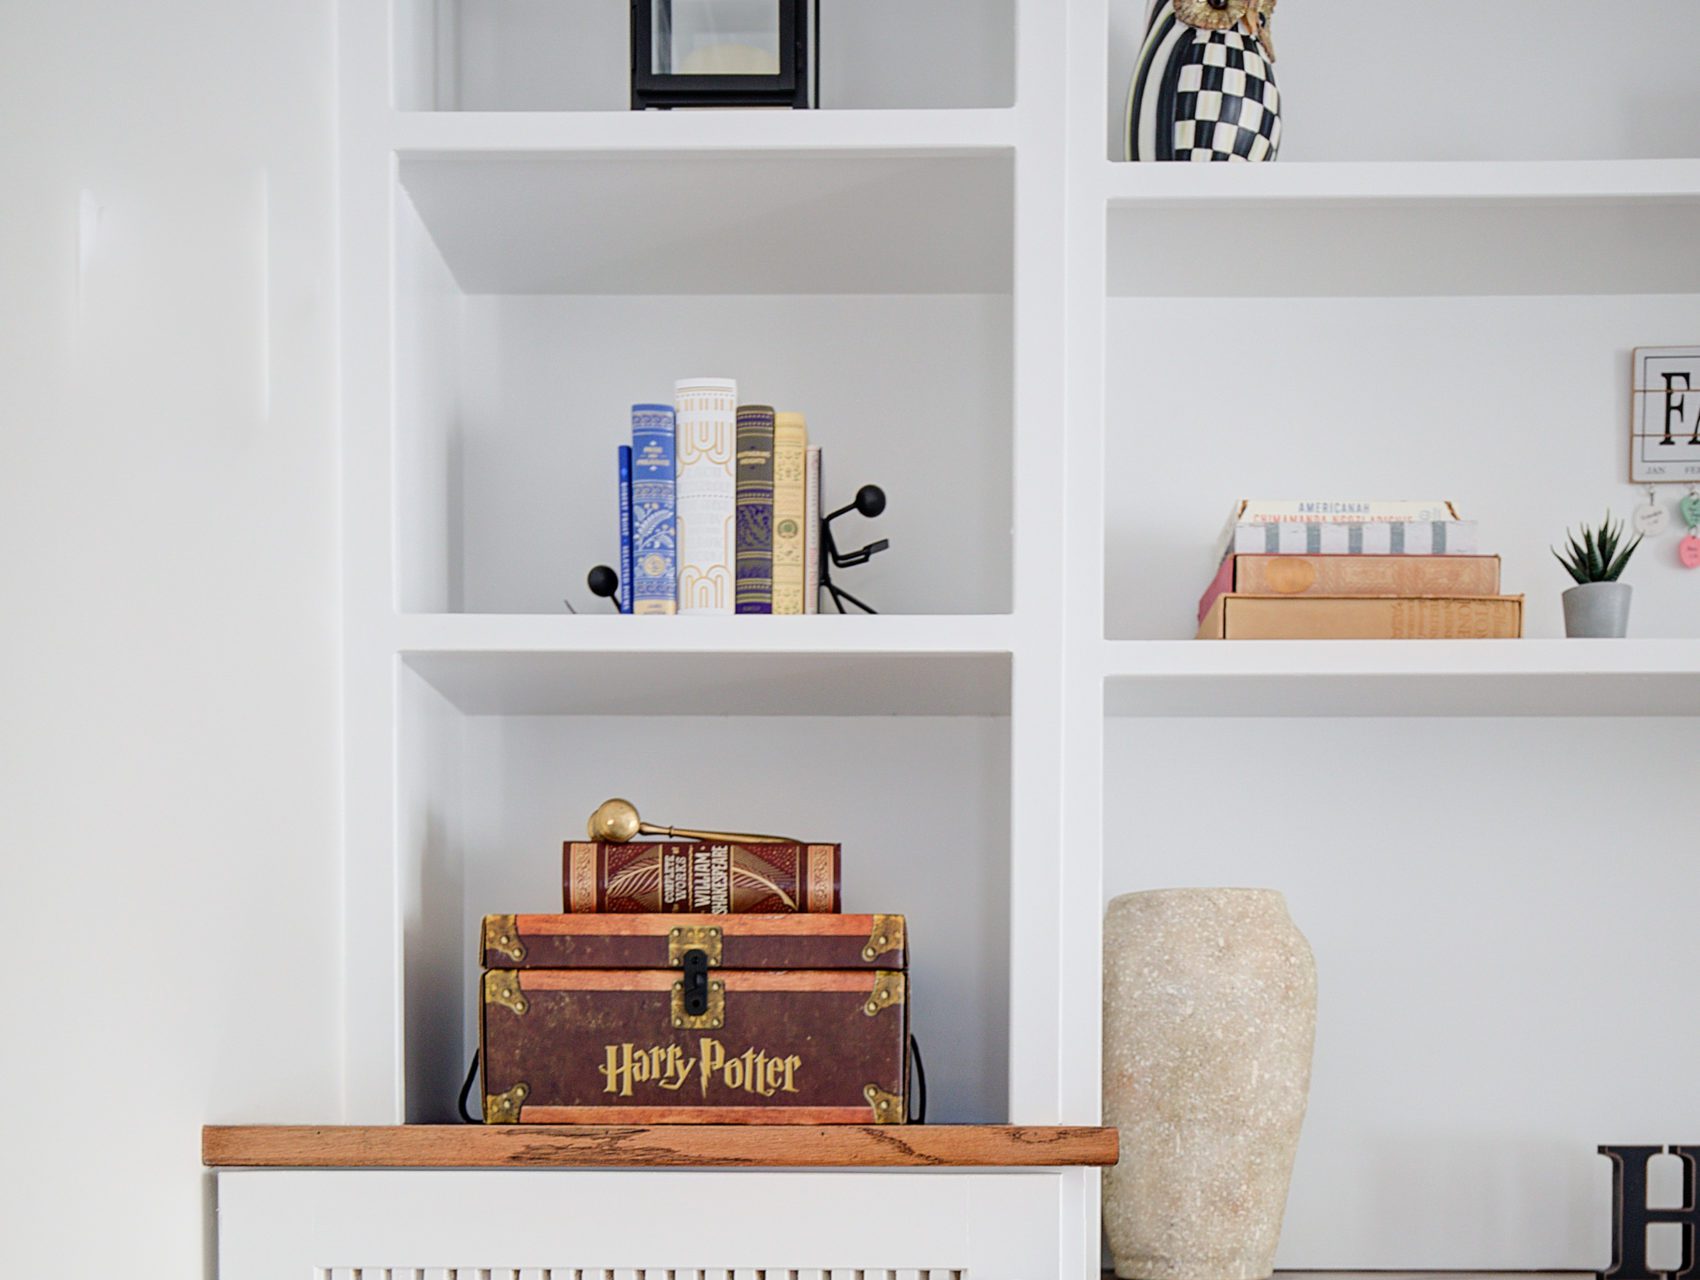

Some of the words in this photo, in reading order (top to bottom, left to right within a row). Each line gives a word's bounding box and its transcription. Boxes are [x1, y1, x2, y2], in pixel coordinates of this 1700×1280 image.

[1659, 372, 1700, 446] F
[1298, 502, 1370, 513] AMERICANAH
[664, 855, 675, 904] COMPLETE
[675, 856, 687, 901] WORKS
[694, 852, 711, 908] WILLIAM
[711, 845, 729, 915] SHAKESPEARE
[598, 1043, 697, 1097] Harry
[699, 1037, 802, 1099] Potter
